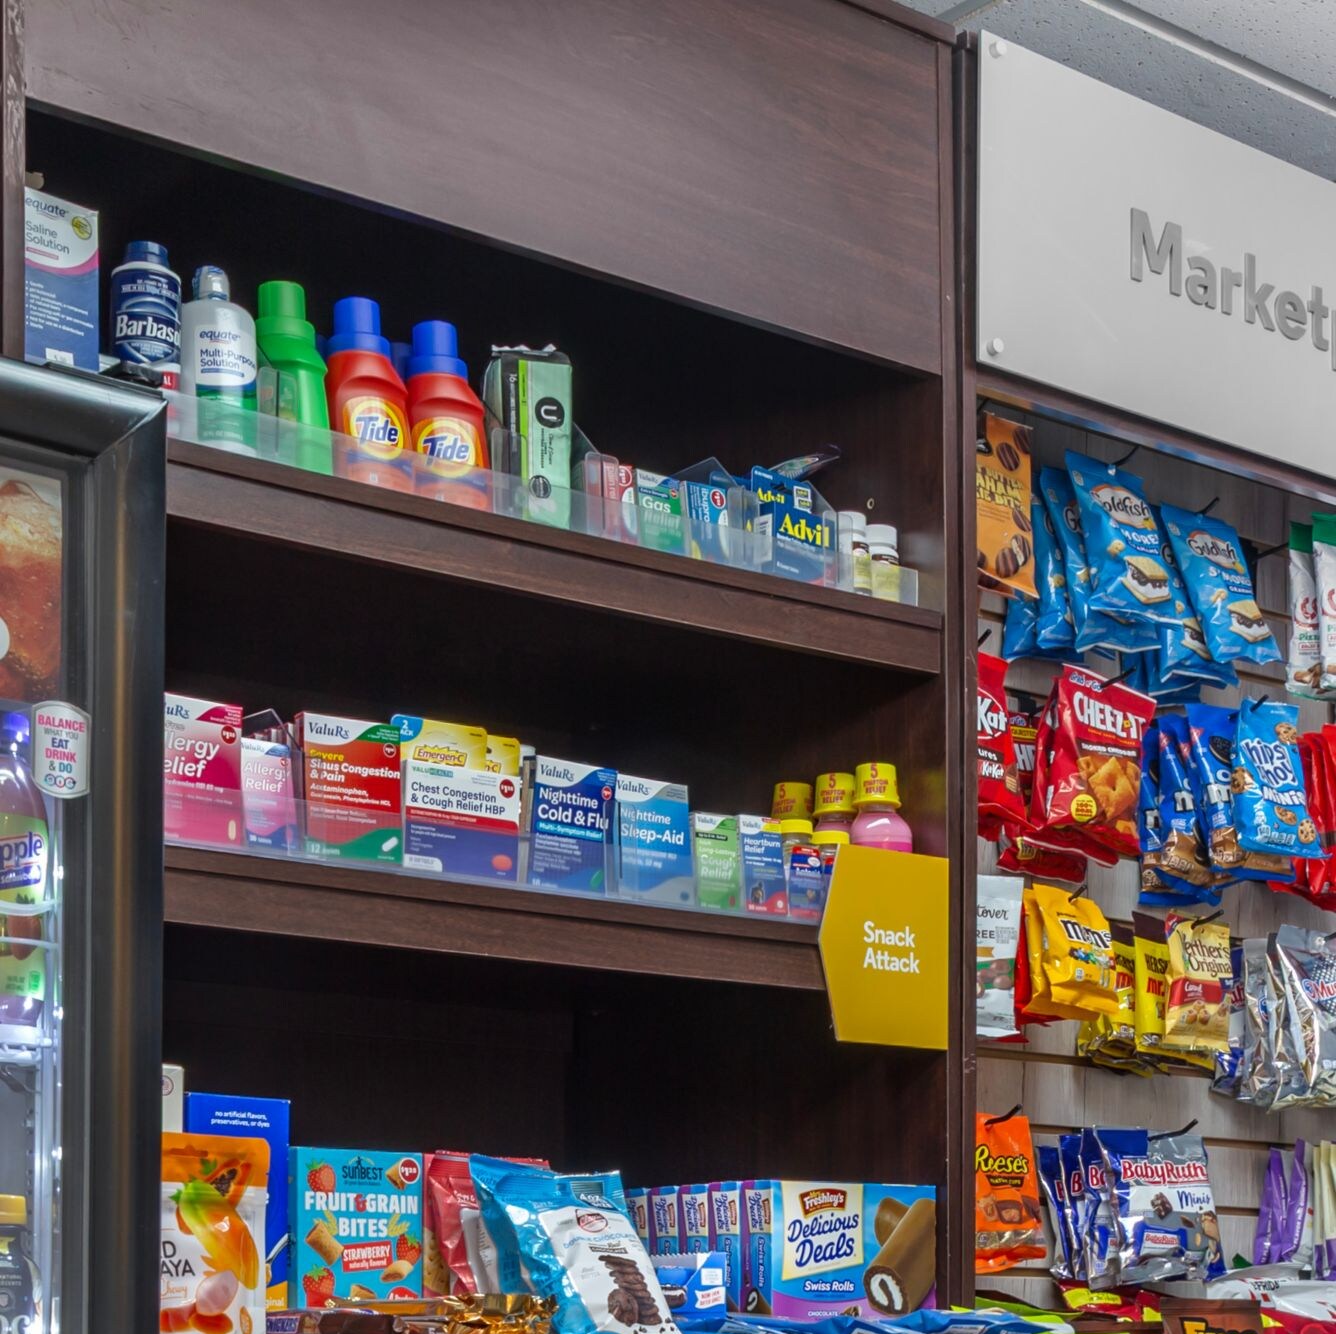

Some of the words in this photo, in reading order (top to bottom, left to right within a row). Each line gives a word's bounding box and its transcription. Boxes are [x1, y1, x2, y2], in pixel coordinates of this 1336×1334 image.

[26, 195, 67, 218] equate
[26, 220, 58, 239] Saline
[26, 231, 70, 255] Solution
[199, 329, 240, 341] equate
[200, 357, 240, 370] Solution
[355, 415, 399, 445] Tide
[423, 434, 470, 465] Tide
[642, 495, 671, 514] Gas
[757, 487, 785, 504] Advil
[779, 513, 830, 548] Advil
[165, 702, 190, 719] uRx
[1073, 691, 1146, 741] CHEEZ-IT
[37, 713, 86, 733] BALANCE
[309, 721, 350, 740] ValuRx
[402, 719, 409, 730] 2
[44, 727, 63, 736] WHAT
[65, 731, 79, 740] YOU
[400, 728, 414, 738] ACK
[51, 737, 70, 750] EAT
[165, 729, 220, 761] llergy
[45, 747, 77, 763] DRINK
[310, 749, 345, 761] Severe
[417, 748, 465, 764] Emergen-C
[48, 760, 56, 771] &
[58, 762, 73, 774] DO
[164, 756, 207, 778] elief
[243, 761, 290, 781] Allergy
[310, 758, 340, 771] Sinus
[341, 762, 401, 779] Congestion
[310, 769, 319, 779] &
[320, 771, 346, 783] Pain
[540, 763, 575, 783] ValuRx
[870, 762, 878, 778] 5
[245, 777, 283, 793] Relief
[616, 779, 650, 796] ValuRx
[828, 773, 837, 788] 5
[411, 781, 440, 795] Chest
[442, 785, 497, 803] Congestion
[539, 786, 599, 809] Nighttime
[410, 792, 419, 803] &
[421, 794, 454, 810] Cough
[456, 799, 483, 813] Relief
[484, 804, 506, 816] HBP
[537, 803, 572, 823] Cold
[573, 810, 586, 826] &
[587, 812, 609, 830] Flu
[620, 806, 671, 826] Nighttime
[539, 821, 586, 836] Multi-Symptom
[620, 823, 685, 846] Sleep-Aid
[0, 832, 43, 869] pple
[743, 837, 781, 848] Heartburn
[744, 844, 765, 854] Relief
[977, 903, 1009, 921] tover
[863, 920, 916, 949] Snack
[977, 930, 996, 939] REE
[863, 947, 920, 974] Attack
[215, 1110, 223, 1118] no
[223, 1110, 247, 1119] artificial
[247, 1111, 268, 1121] flavors,
[342, 1165, 384, 1181] SUNBEST
[304, 1191, 357, 1212] FRUIT
[366, 1193, 419, 1215] GRAIN
[803, 1193, 844, 1210] Freshley's
[1176, 1190, 1212, 1210] Minis
[338, 1217, 388, 1238] BITES
[787, 1211, 860, 1243] Delicious
[342, 1245, 391, 1262] STRAWBERRY
[795, 1232, 856, 1268] Deals
[161, 1259, 196, 1278] AYA
[804, 1279, 831, 1292] Swiss
[831, 1280, 855, 1292] Rolls
[265, 1296, 285, 1309] ginal
[807, 1310, 839, 1318] CHOCOLATE
